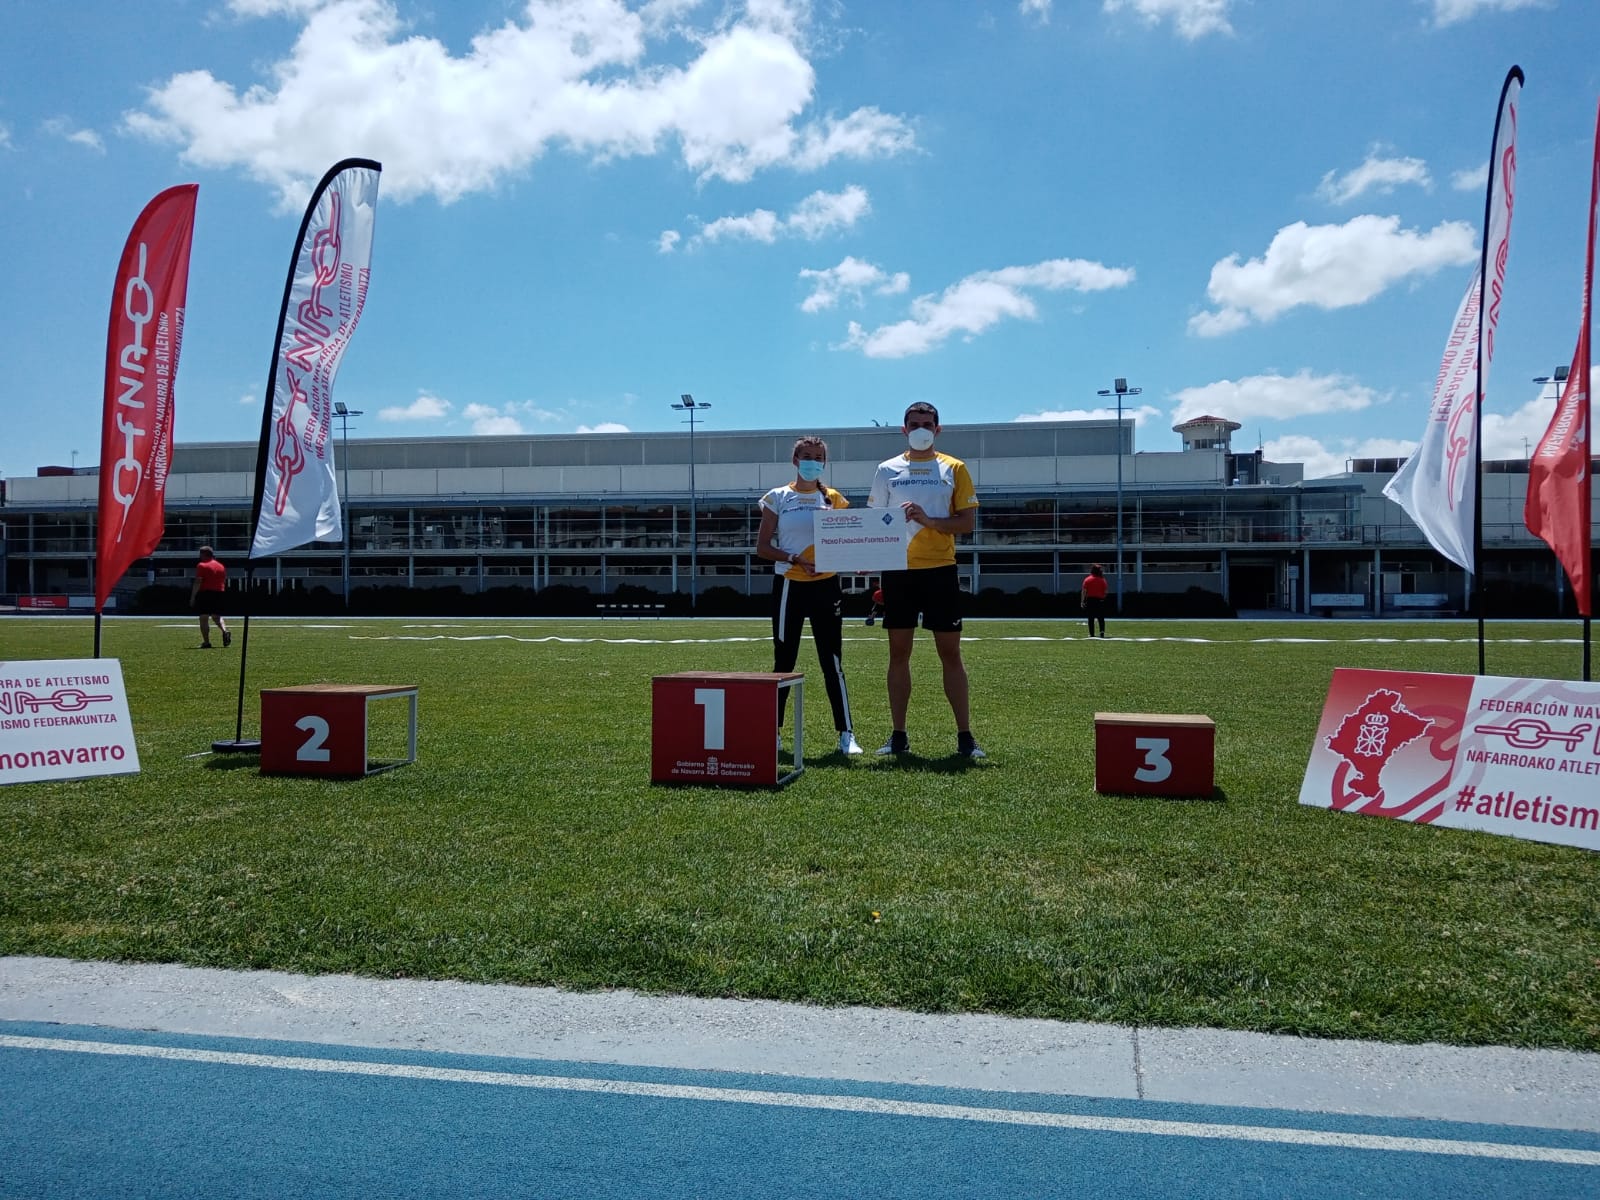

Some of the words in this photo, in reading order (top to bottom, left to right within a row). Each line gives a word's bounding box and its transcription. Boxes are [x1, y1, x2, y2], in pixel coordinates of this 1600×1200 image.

[339, 263, 353, 320] ATLETISMO
[155, 311, 169, 361] ATLETISMO
[338, 321, 348, 336] DE
[156, 363, 169, 375] DE
[155, 378, 168, 421] NAVARRA
[315, 393, 330, 459] NAFARROAKO
[26, 678, 42, 688] DE
[45, 675, 110, 687] ATLETISMO
[34, 713, 117, 728] FEDERAKUNTZA
[694, 688, 725, 750] 1
[1479, 698, 1568, 717] FEDERACIÓN
[294, 715, 331, 762] 2
[676, 760, 704, 768] Gobierno
[1133, 737, 1173, 783] 3
[1466, 749, 1556, 771] NAFARROAKO
